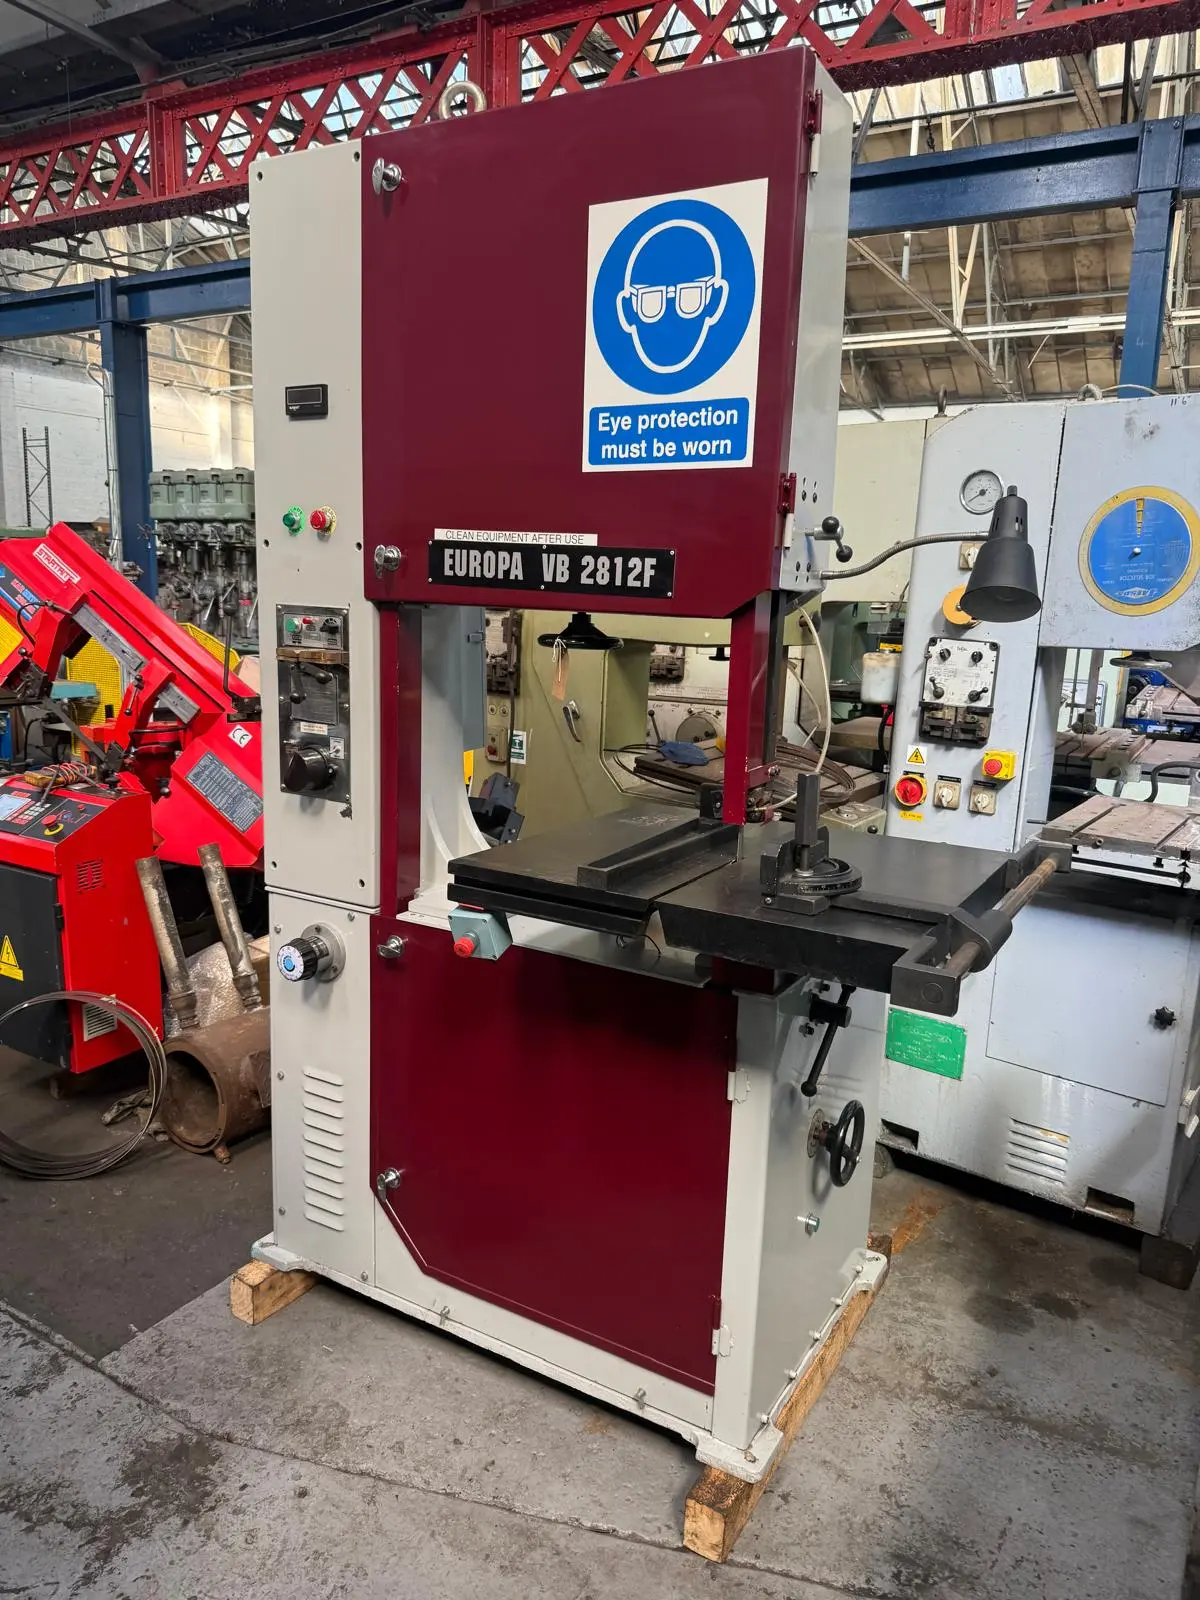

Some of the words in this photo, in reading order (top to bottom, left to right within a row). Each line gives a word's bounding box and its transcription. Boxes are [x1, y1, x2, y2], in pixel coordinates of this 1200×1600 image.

[598, 412, 632, 436] Eye
[637, 406, 738, 435] protection
[601, 440, 647, 459] must
[652, 438, 677, 457] be
[682, 438, 732, 456] worn
[445, 530, 475, 541] CLEAN
[476, 531, 530, 543] EQUIPMENT
[531, 533, 562, 544] AFTER
[564, 534, 585, 545] USE
[443, 548, 524, 581] EUROPA
[541, 553, 570, 583] VB
[580, 555, 657, 588] 2812F
